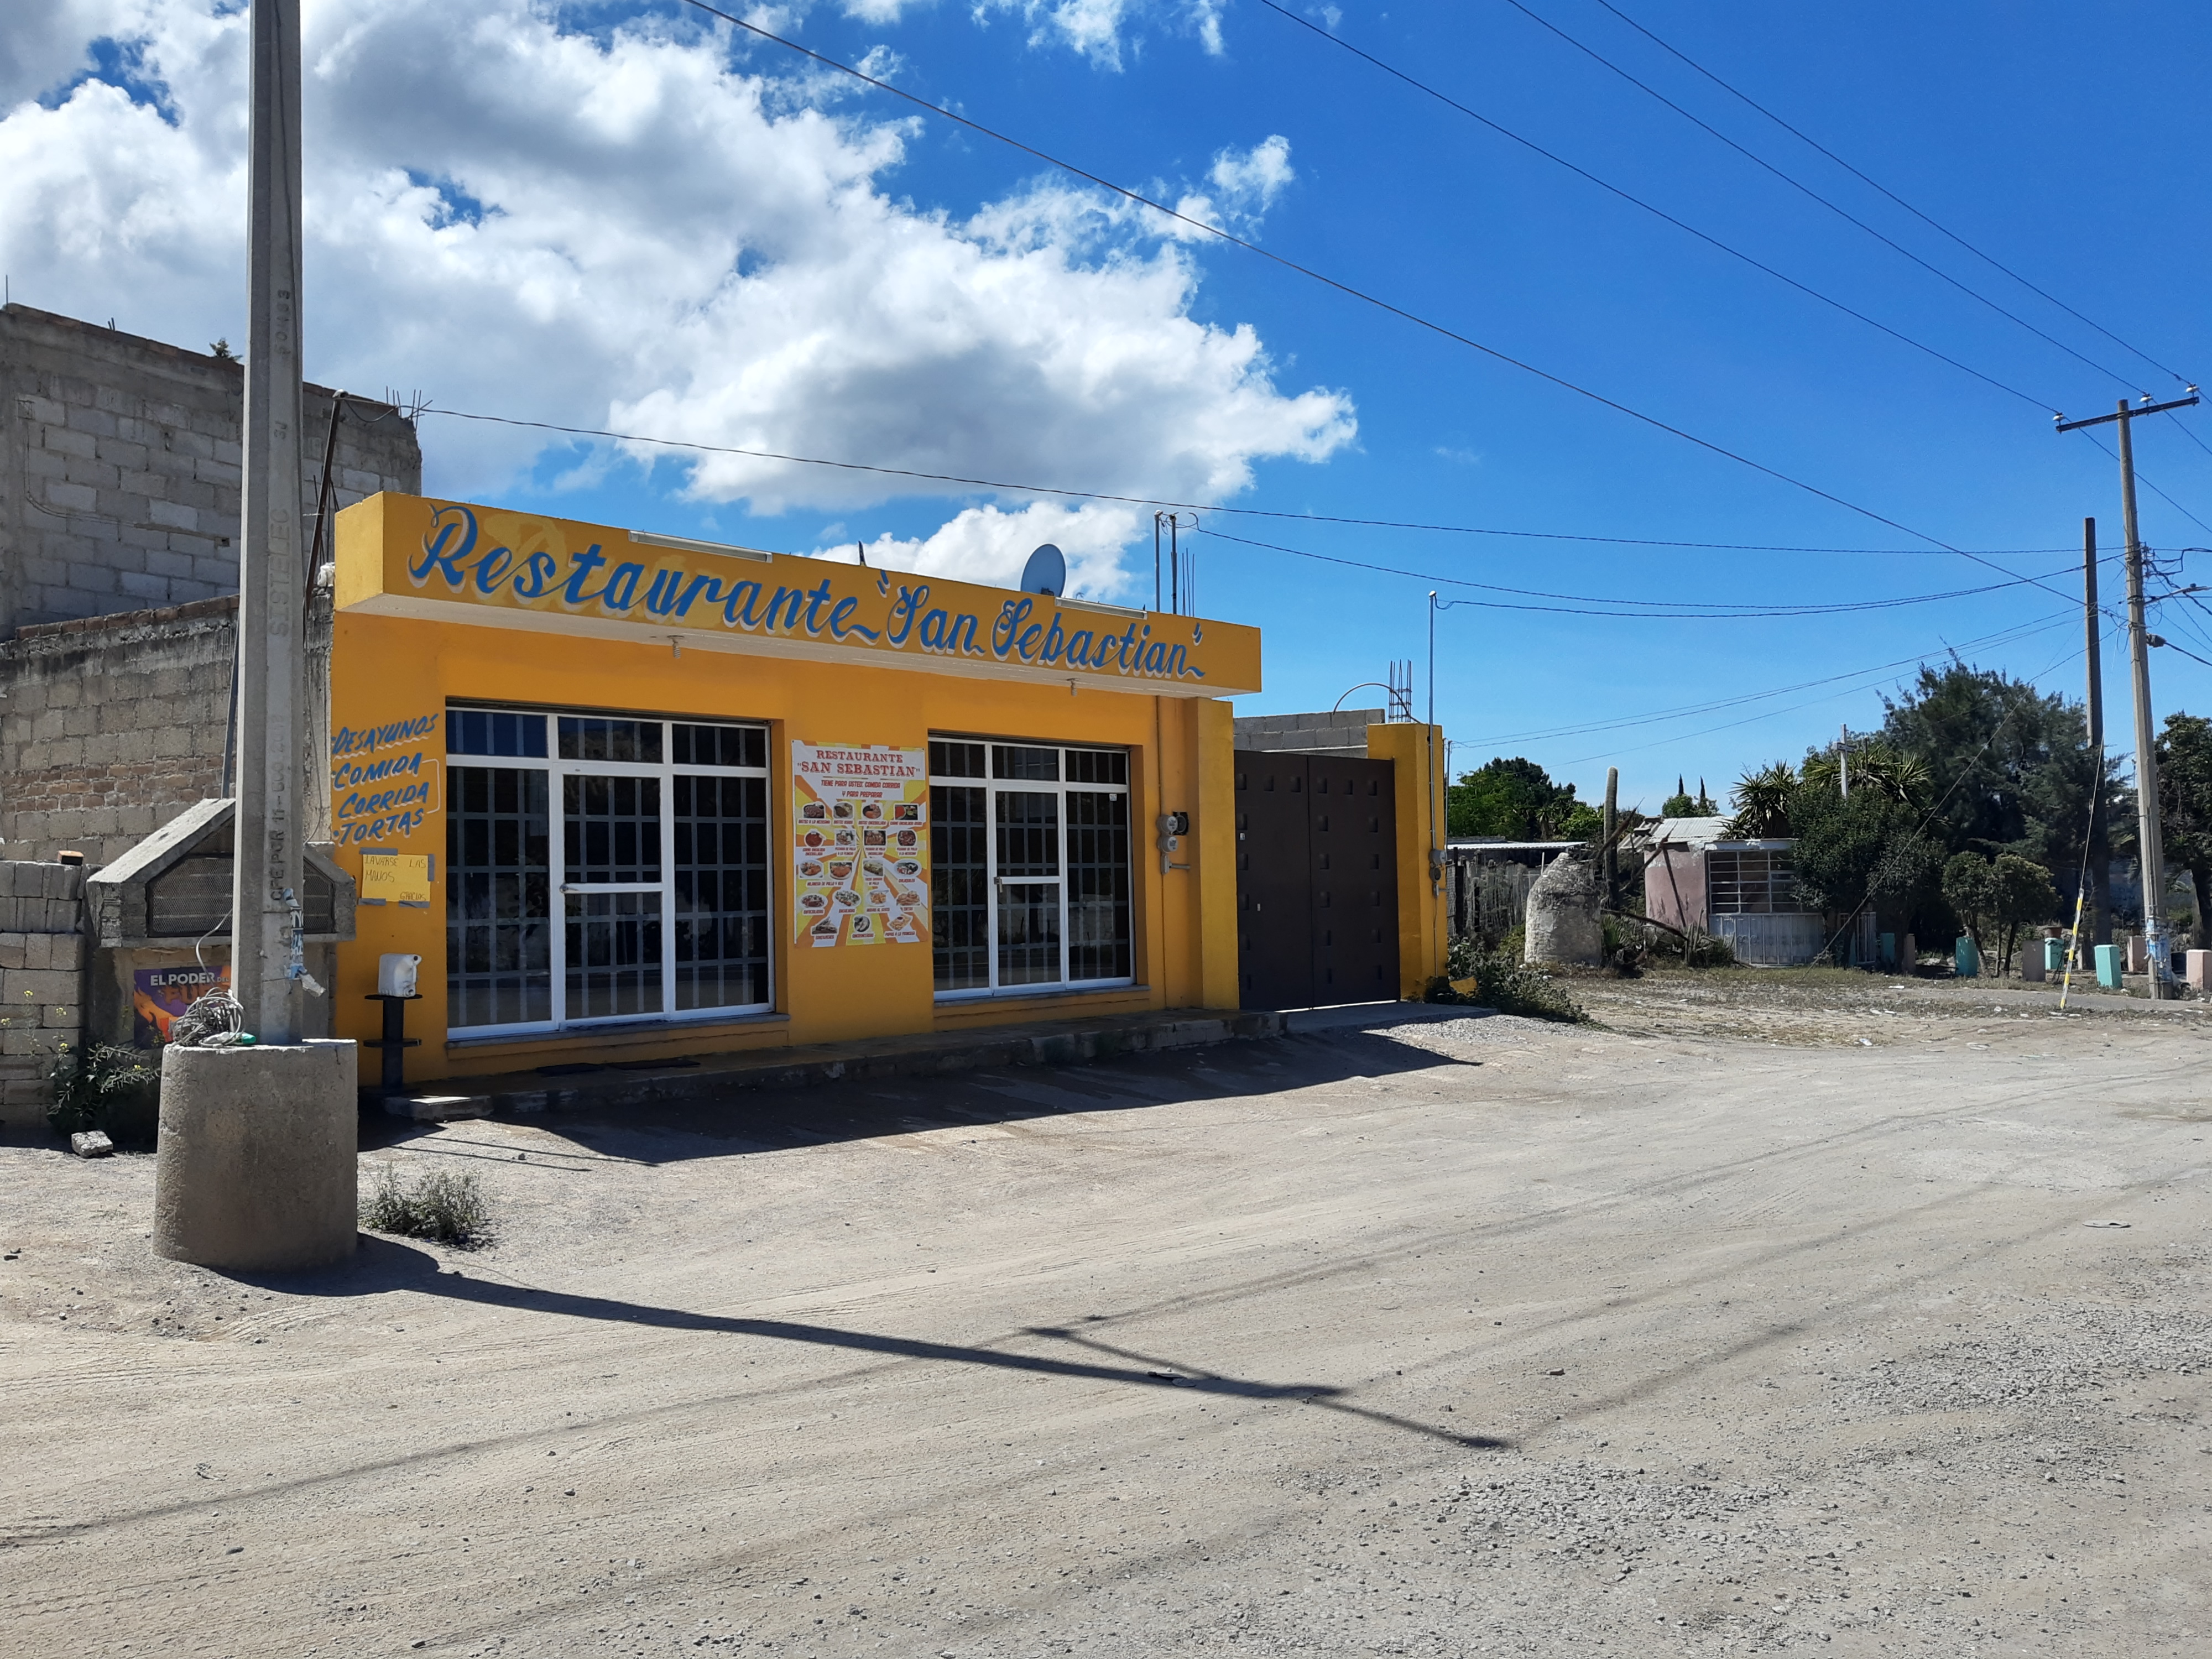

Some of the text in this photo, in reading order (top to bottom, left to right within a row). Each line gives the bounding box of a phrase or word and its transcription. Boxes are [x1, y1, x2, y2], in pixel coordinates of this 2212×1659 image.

[407, 504, 879, 640] Restaurante
[332, 713, 439, 754] DESAYUNOS
[334, 752, 422, 790] COMIDA
[797, 761, 920, 777] "SAN SEBASTIAN"
[816, 750, 903, 763] RESTAURANTE
[338, 781, 430, 819] CORRIDA
[340, 808, 424, 845] TORTAS
[409, 859, 426, 868] LAS
[270, 869, 285, 901] CFE
[150, 974, 166, 987] EL
[168, 972, 215, 985] PODER
